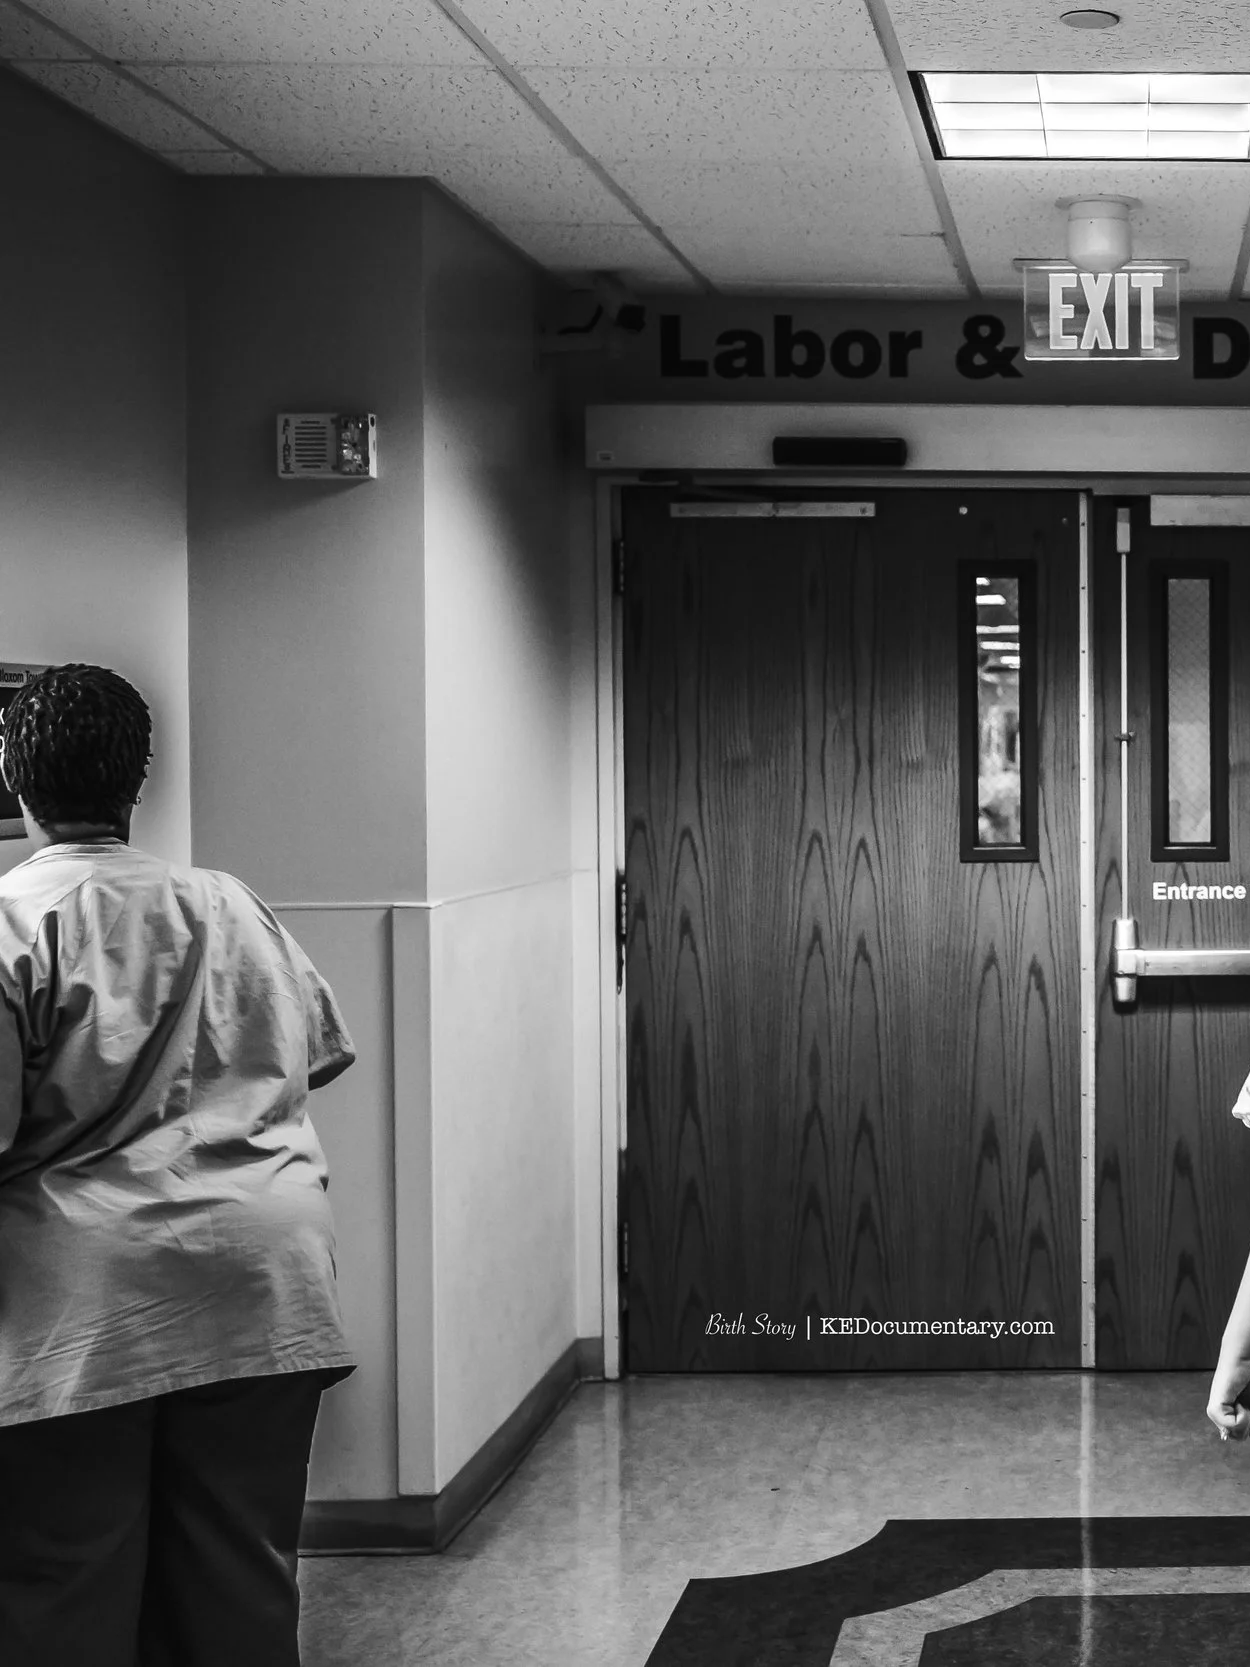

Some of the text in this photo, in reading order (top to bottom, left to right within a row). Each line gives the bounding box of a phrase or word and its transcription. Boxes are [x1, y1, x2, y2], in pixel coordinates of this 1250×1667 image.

[1048, 272, 1164, 351] EXIT
[659, 314, 922, 380] Labor
[955, 314, 1023, 380] &
[1152, 881, 1247, 900] Entrance
